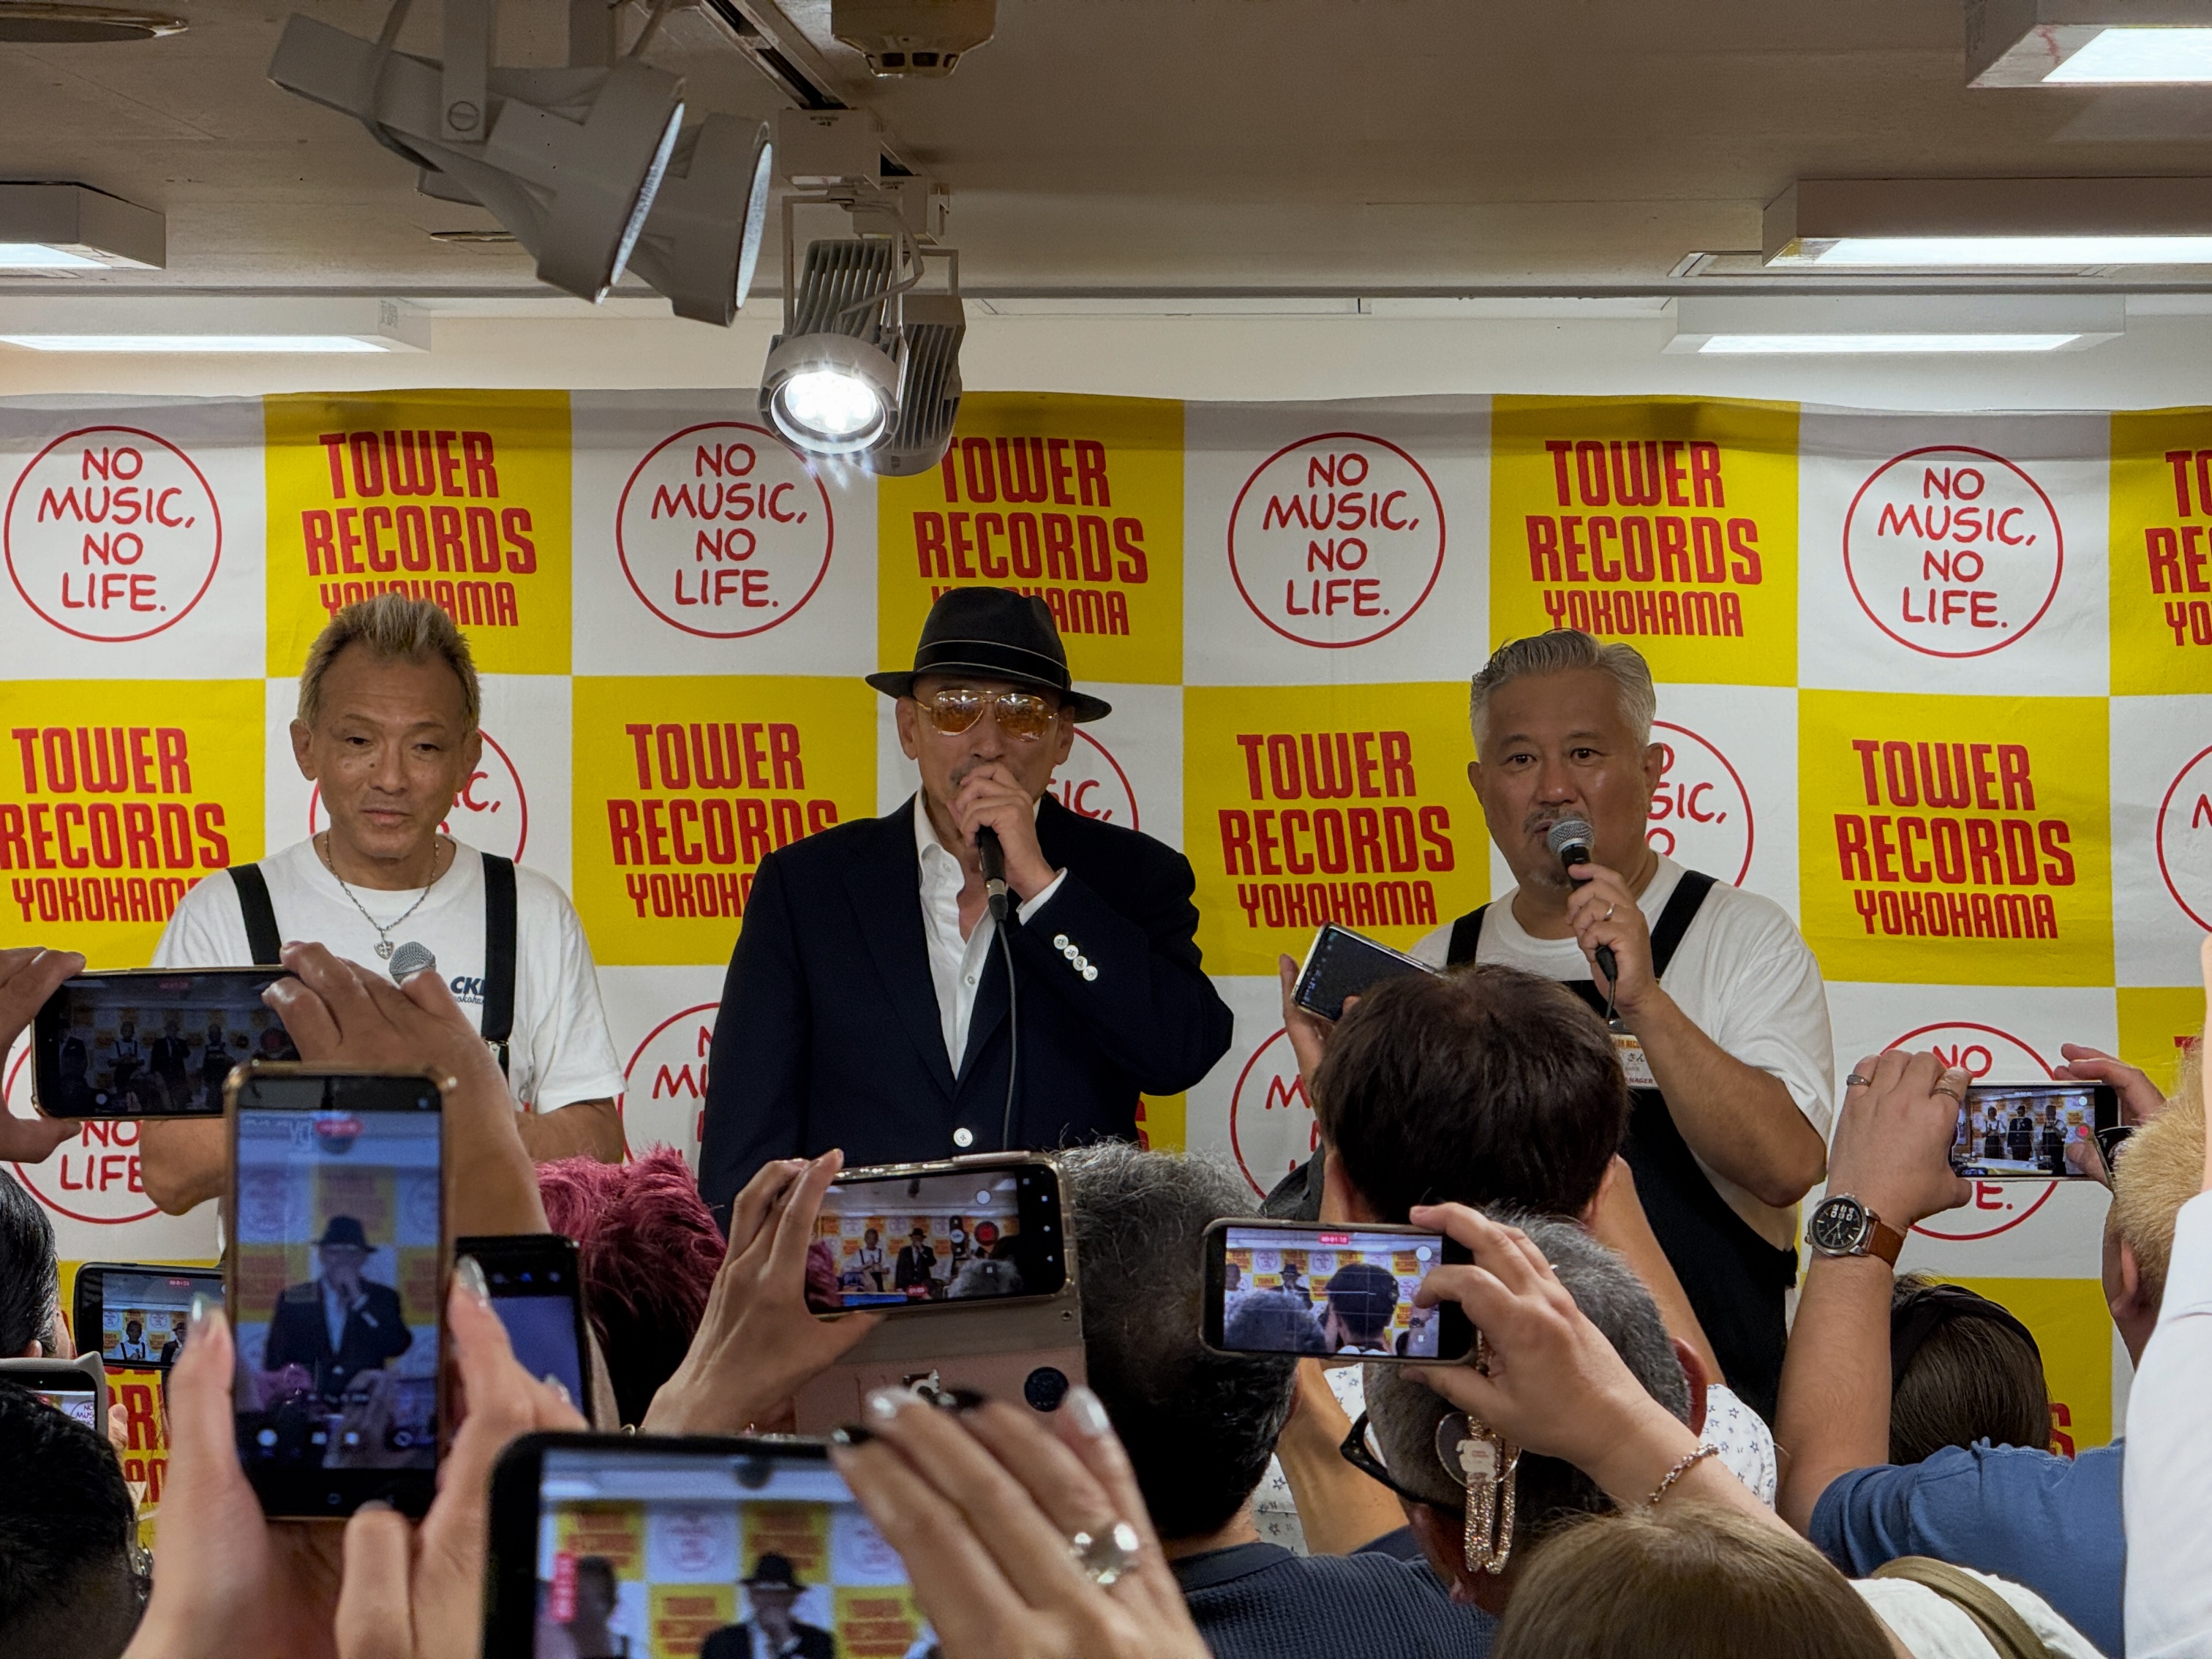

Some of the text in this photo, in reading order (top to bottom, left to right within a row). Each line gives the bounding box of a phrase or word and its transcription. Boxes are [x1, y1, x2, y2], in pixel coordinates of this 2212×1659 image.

[83, 448, 143, 481] NO
[319, 430, 499, 499] TOWER
[696, 444, 756, 477] NO
[941, 437, 1111, 507] TOWER
[1309, 454, 1368, 487] NO
[1545, 440, 1724, 508] TOWER
[652, 483, 807, 523] MUSIC,
[1924, 468, 1984, 500] NO
[38, 486, 194, 527] MUSIC,
[1263, 491, 1418, 530] MUSIC,
[1878, 503, 2035, 545] MUSIC,
[83, 533, 143, 565] NO
[302, 505, 537, 576] RECORDS
[696, 528, 756, 561] NO
[913, 512, 1148, 584] RECORDS
[1308, 538, 1367, 572] NO
[1526, 516, 1762, 584] RECORDS
[676, 569, 778, 607] LIFE.
[1924, 550, 1983, 582] NO
[62, 573, 166, 611] LIFE.
[320, 580, 518, 626] YAMA
[1287, 579, 1389, 616] LIFE.
[1543, 590, 1743, 636] YOKOHAMA
[1903, 588, 2006, 628] LIFE.
[12, 728, 192, 794] TOWER
[625, 723, 805, 790] TOWER
[1237, 731, 1416, 800] TOWER
[1853, 740, 2035, 810] TOWER
[1647, 782, 1726, 824] SIC,
[0, 803, 230, 870] RECORDS
[1219, 806, 1455, 876] RECORDS
[1835, 814, 2075, 886] RECORDS
[12, 877, 201, 922] YOKOHAM
[626, 873, 755, 917] YOKOH
[1238, 881, 1437, 928] YOKOHAMA
[1854, 889, 2058, 938] YOKOHAMA
